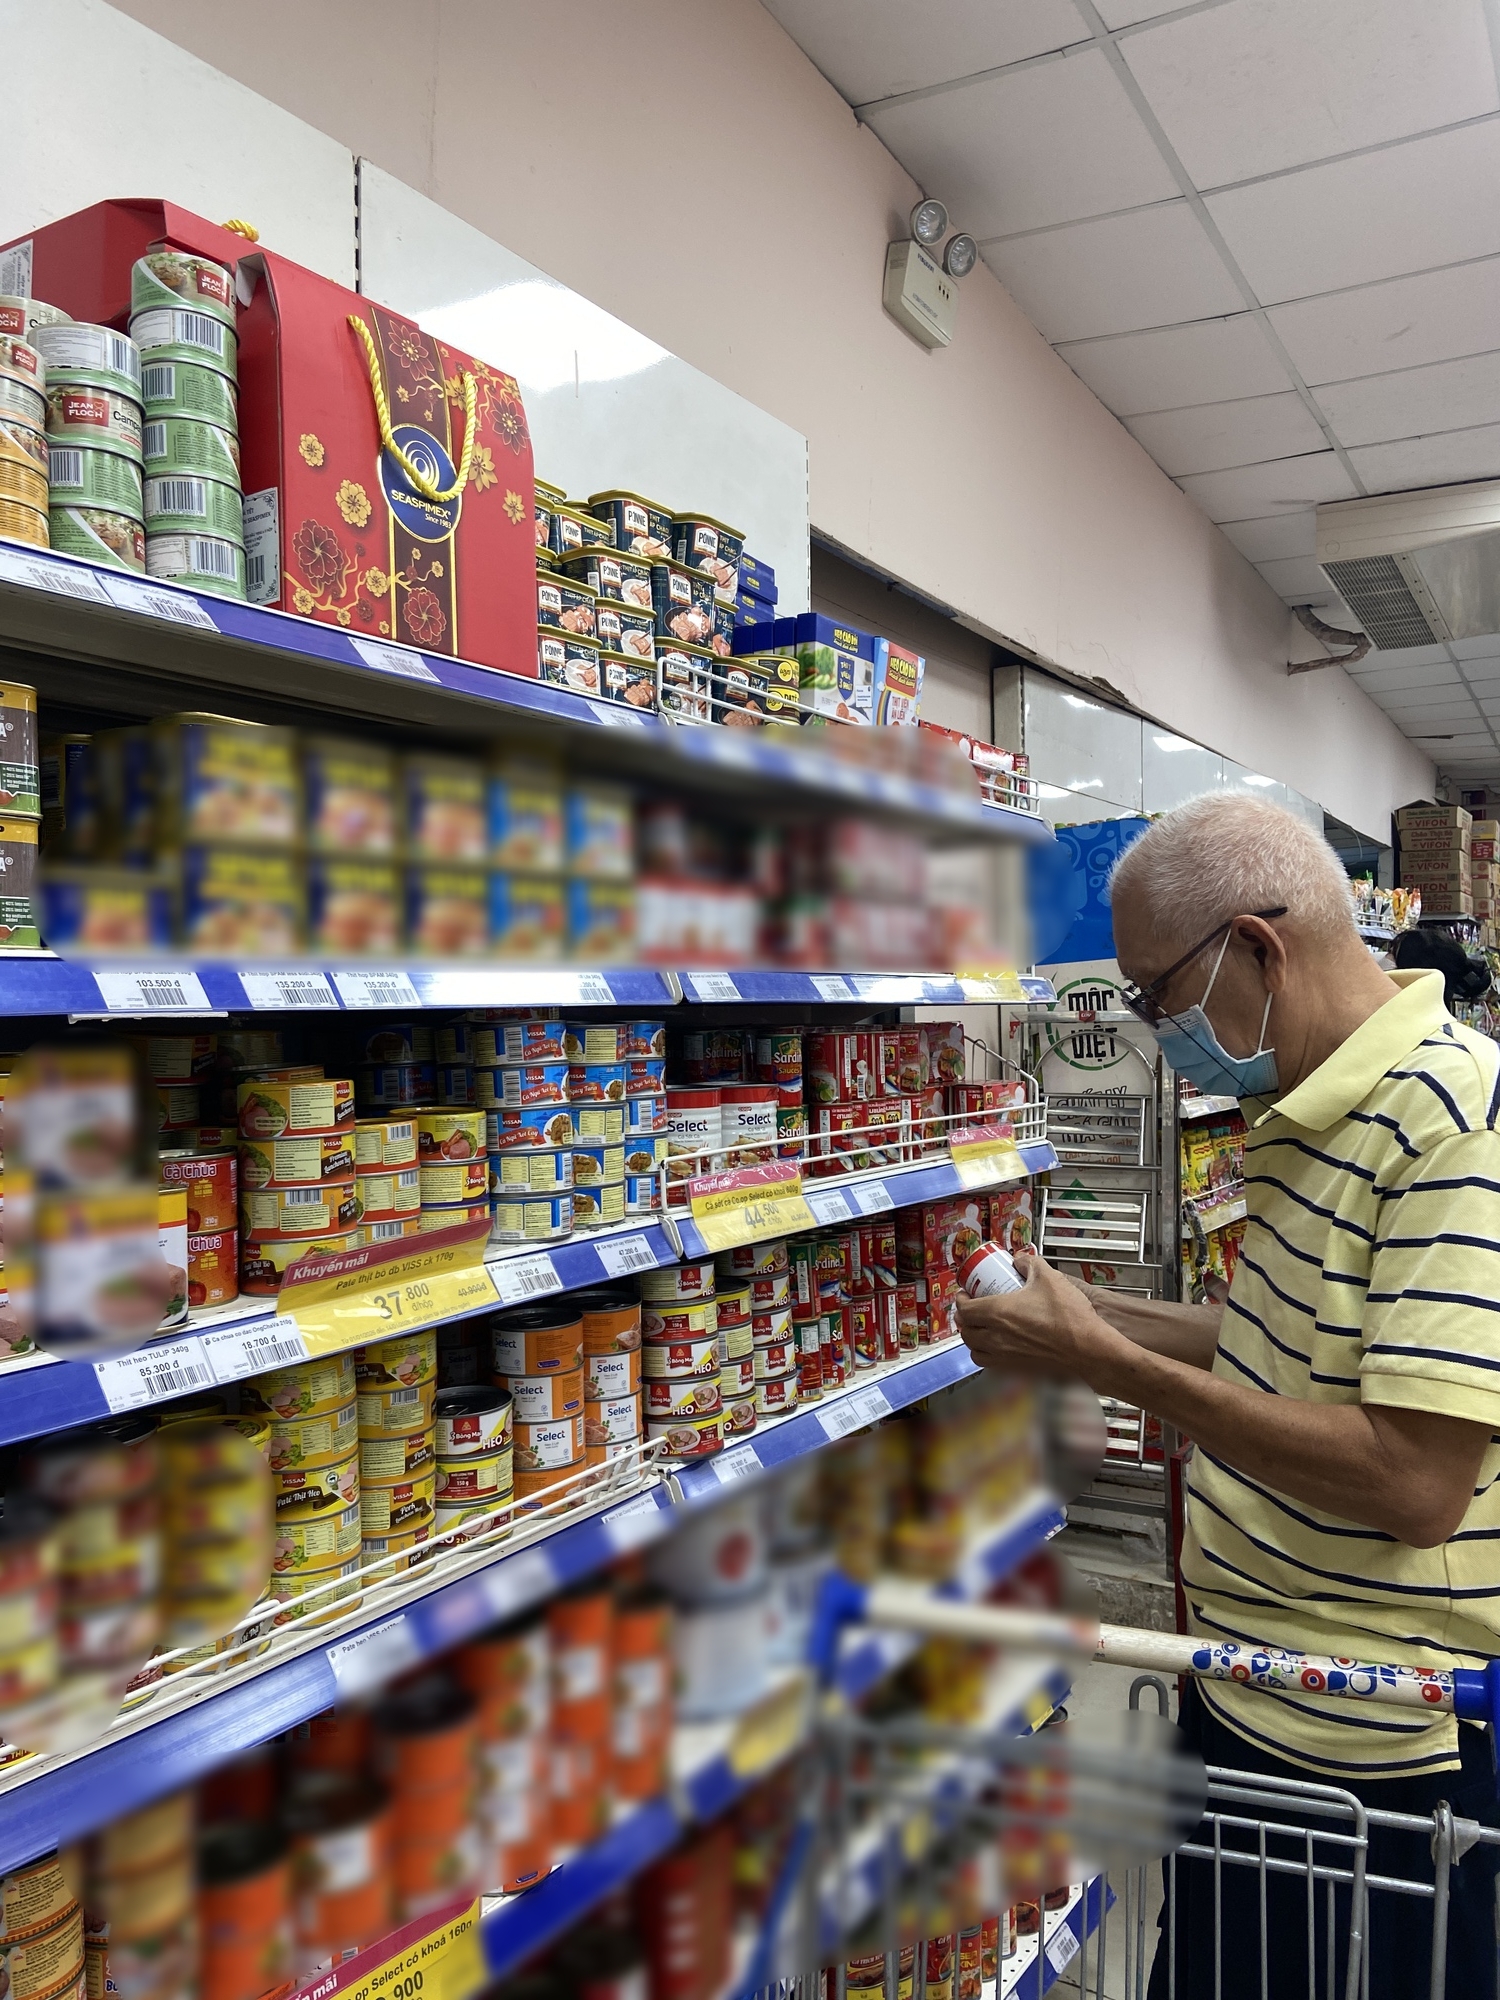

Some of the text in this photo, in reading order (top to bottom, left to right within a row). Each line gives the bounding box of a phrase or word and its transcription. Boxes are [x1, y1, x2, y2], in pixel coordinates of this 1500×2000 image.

[202, 275, 222, 288] JEAN
[202, 282, 226, 297] FLOCH
[68, 402, 93, 410] JEAN
[68, 409, 102, 418] FLOCH
[391, 490, 452, 520] SEASPIMEX
[425, 513, 452, 529] Since 1983
[1417, 862, 1449, 870] VIFON
[1411, 883, 1448, 891] VIFON
[738, 1113, 771, 1125] Select
[667, 1119, 708, 1132] Select
[163, 1163, 217, 1180] Cà Chua
[749, 1191, 765, 1201] Select
[190, 1236, 222, 1251] Chua
[619, 1248, 633, 1256] 47.200
[293, 1252, 369, 1280] Khuyến mãi
[336, 1279, 356, 1290] Pate
[358, 1272, 373, 1284] thịt
[374, 1267, 386, 1280] bò
[402, 1259, 422, 1272] VISS
[423, 1256, 433, 1265] ck
[435, 1251, 454, 1265] 170g
[756, 1265, 774, 1274] HEO
[516, 1268, 534, 1277] 18.300
[702, 1286, 714, 1296] HEO
[374, 1282, 429, 1320] 37.800
[776, 1297, 788, 1306] HEO
[280, 1319, 292, 1327] 210g
[774, 1331, 788, 1341] HEO
[242, 1338, 269, 1350] 18.700
[116, 1345, 189, 1369] Thit heo TULIP 340g
[139, 1361, 171, 1377] 85.300
[597, 1363, 624, 1372] Select
[694, 1364, 712, 1375] HEO
[514, 1386, 544, 1395] Select
[608, 1405, 632, 1416] Select
[672, 1406, 694, 1416] HEO
[408, 1437, 425, 1445] VISSAN
[449, 1429, 482, 1442] 3 Bông Mai
[537, 1430, 565, 1442] Select
[482, 1434, 502, 1450] HEO
[414, 1448, 427, 1459] Pork
[308, 1489, 321, 1498] Heo
[393, 1492, 413, 1500] VISSAN
[400, 1503, 416, 1514] Pork
[415, 1532, 429, 1540] VISSAN
[342, 1641, 355, 1653] Pate
[371, 1936, 446, 1991] Select có khoá
[313, 1974, 338, 1998] mãi
